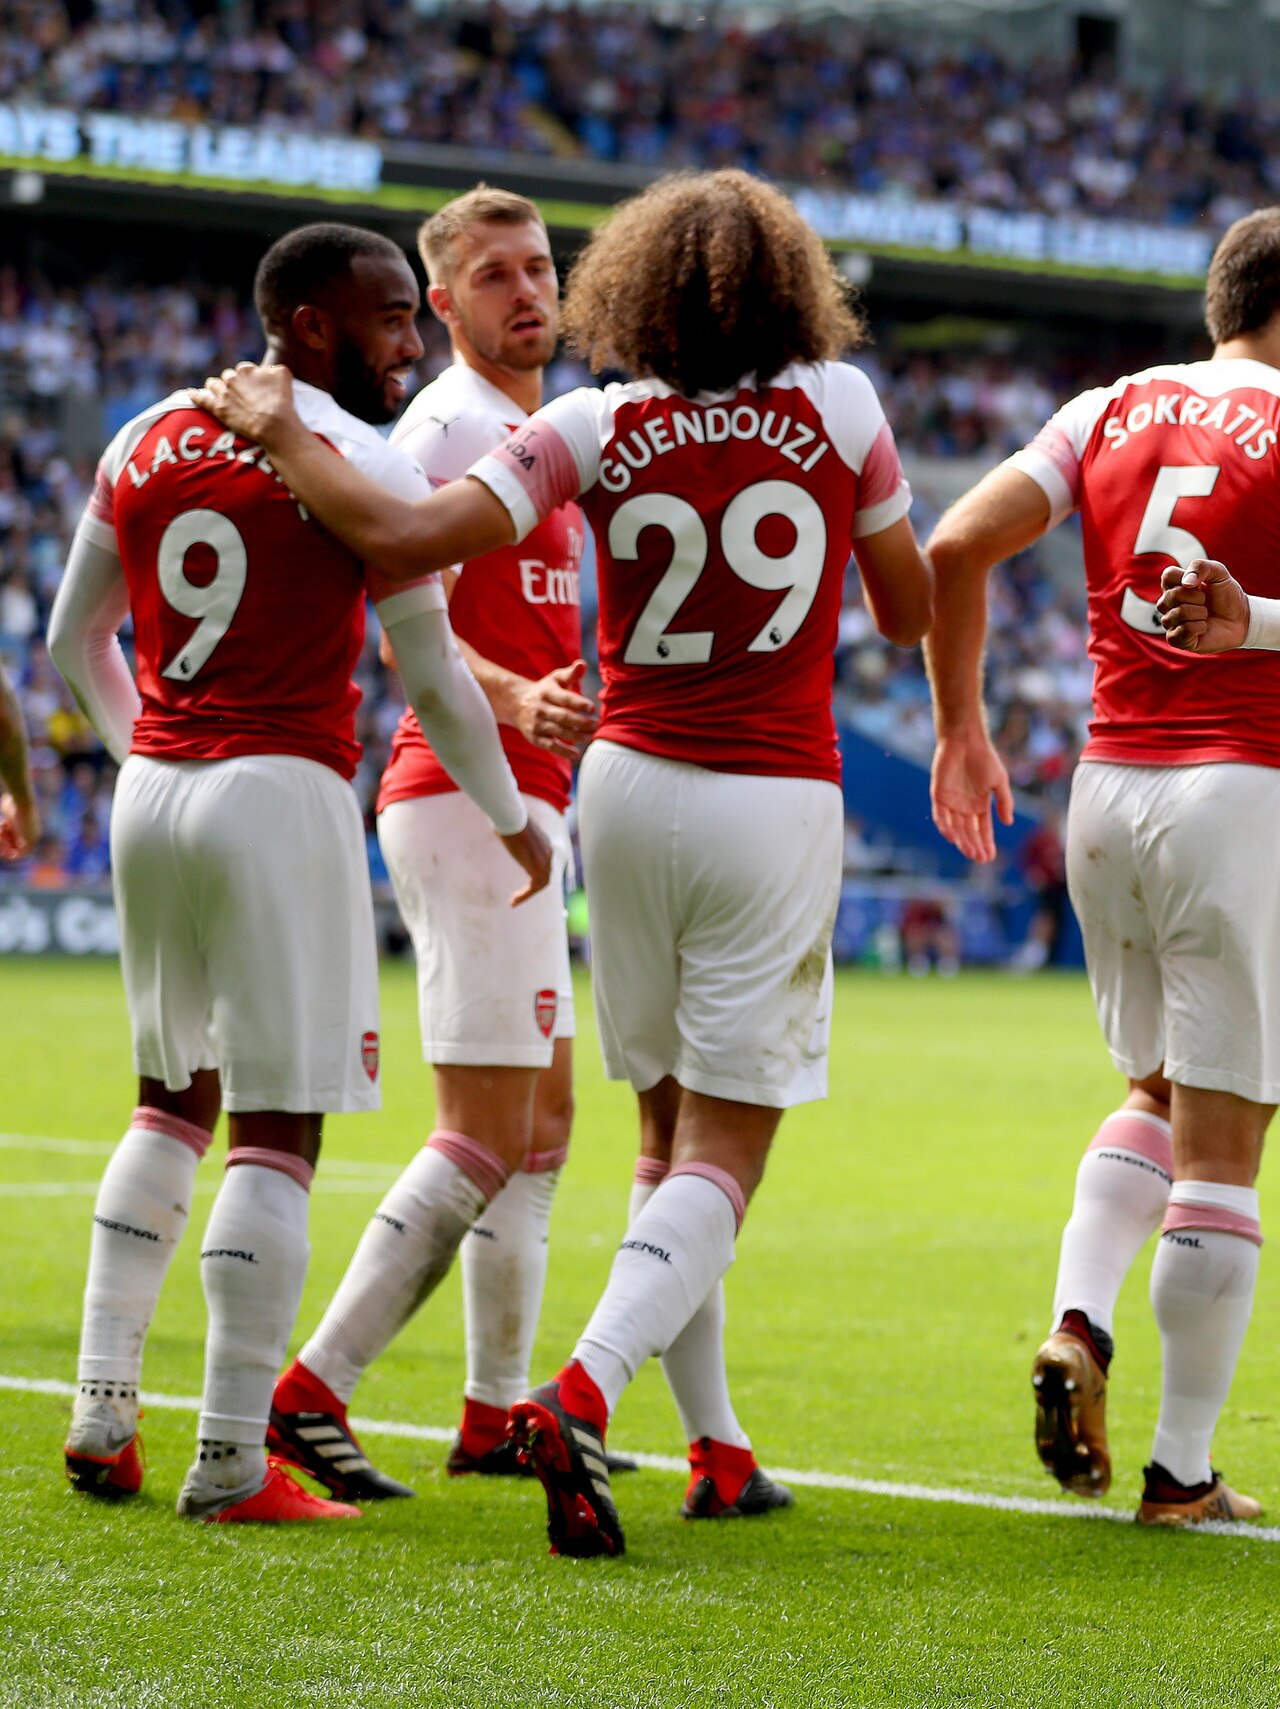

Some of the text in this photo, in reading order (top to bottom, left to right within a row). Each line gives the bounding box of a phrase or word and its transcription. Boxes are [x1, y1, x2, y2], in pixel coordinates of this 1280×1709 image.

[599, 405, 830, 494] GUENDOUZI
[1103, 394, 1277, 460] SOKRATIS
[157, 508, 248, 682] 9
[608, 479, 828, 666] 29
[1120, 465, 1221, 635] 5
